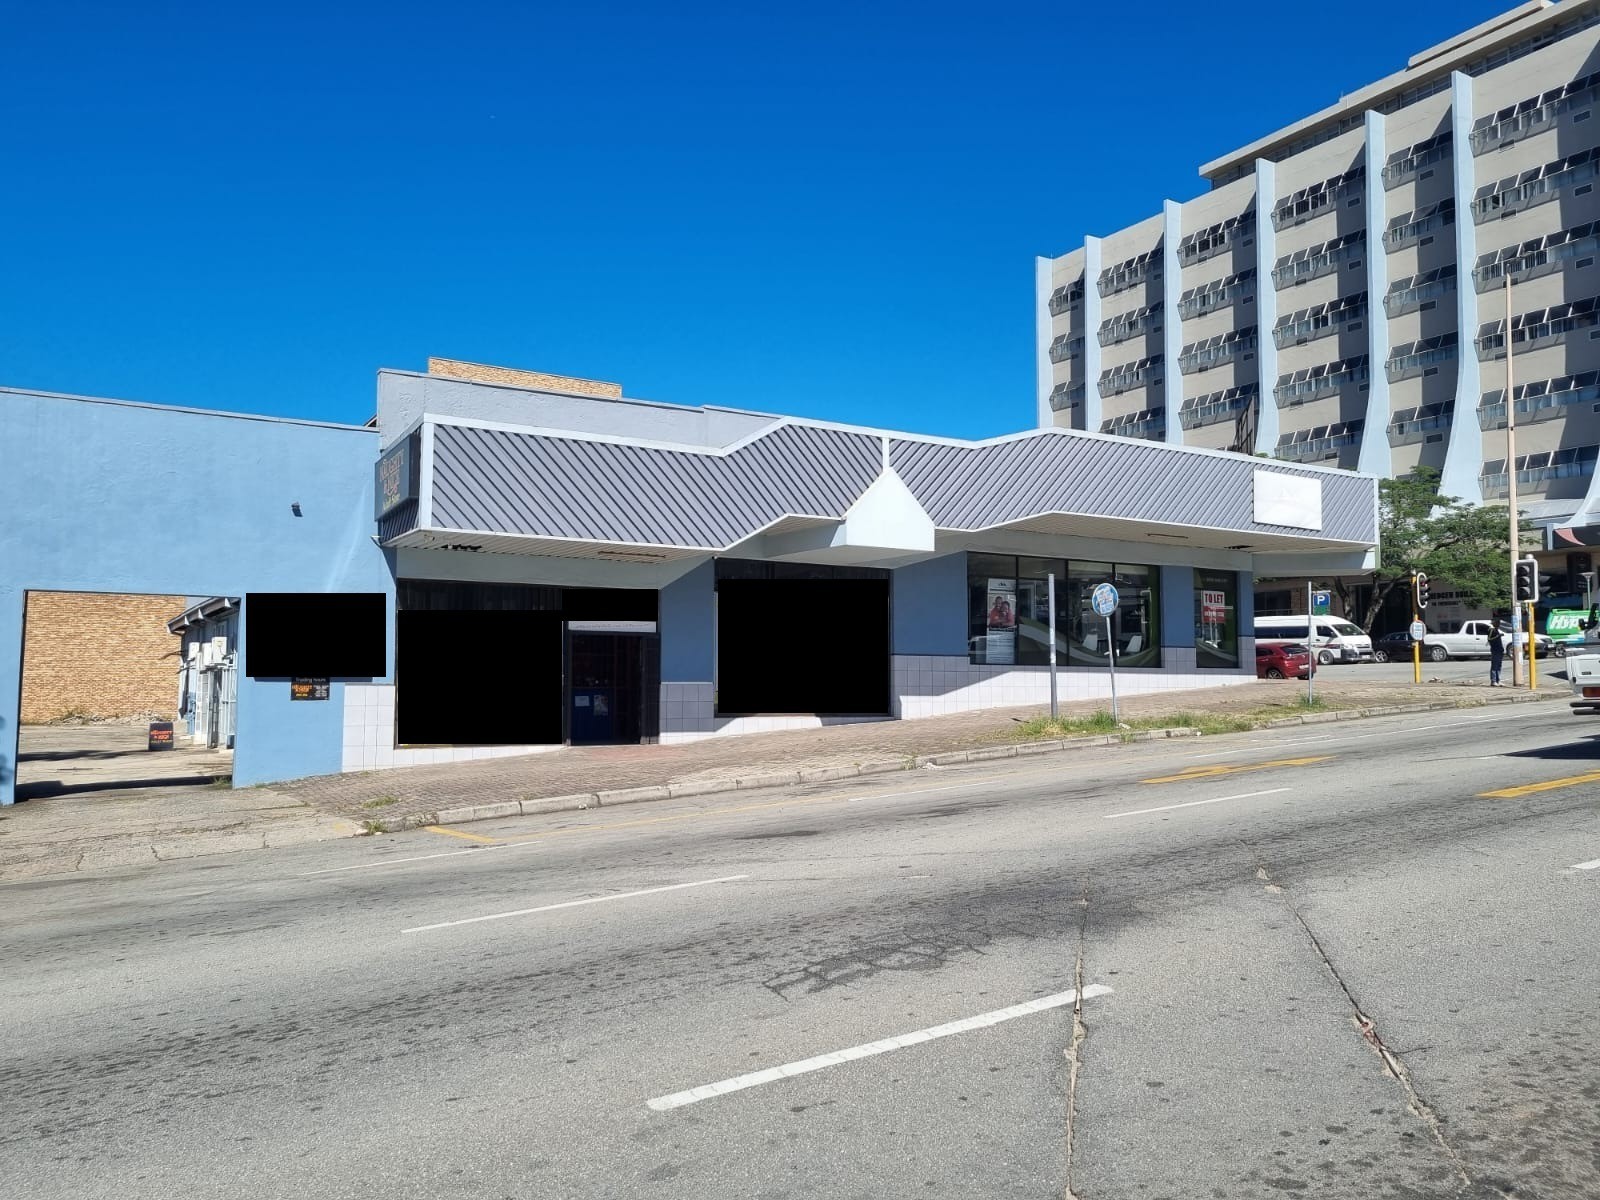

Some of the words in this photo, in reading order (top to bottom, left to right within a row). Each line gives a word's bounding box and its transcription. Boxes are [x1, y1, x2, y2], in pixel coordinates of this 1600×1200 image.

[1204, 593, 1213, 604] TO
[1213, 593, 1224, 604] LET
[1317, 595, 1326, 605] P
